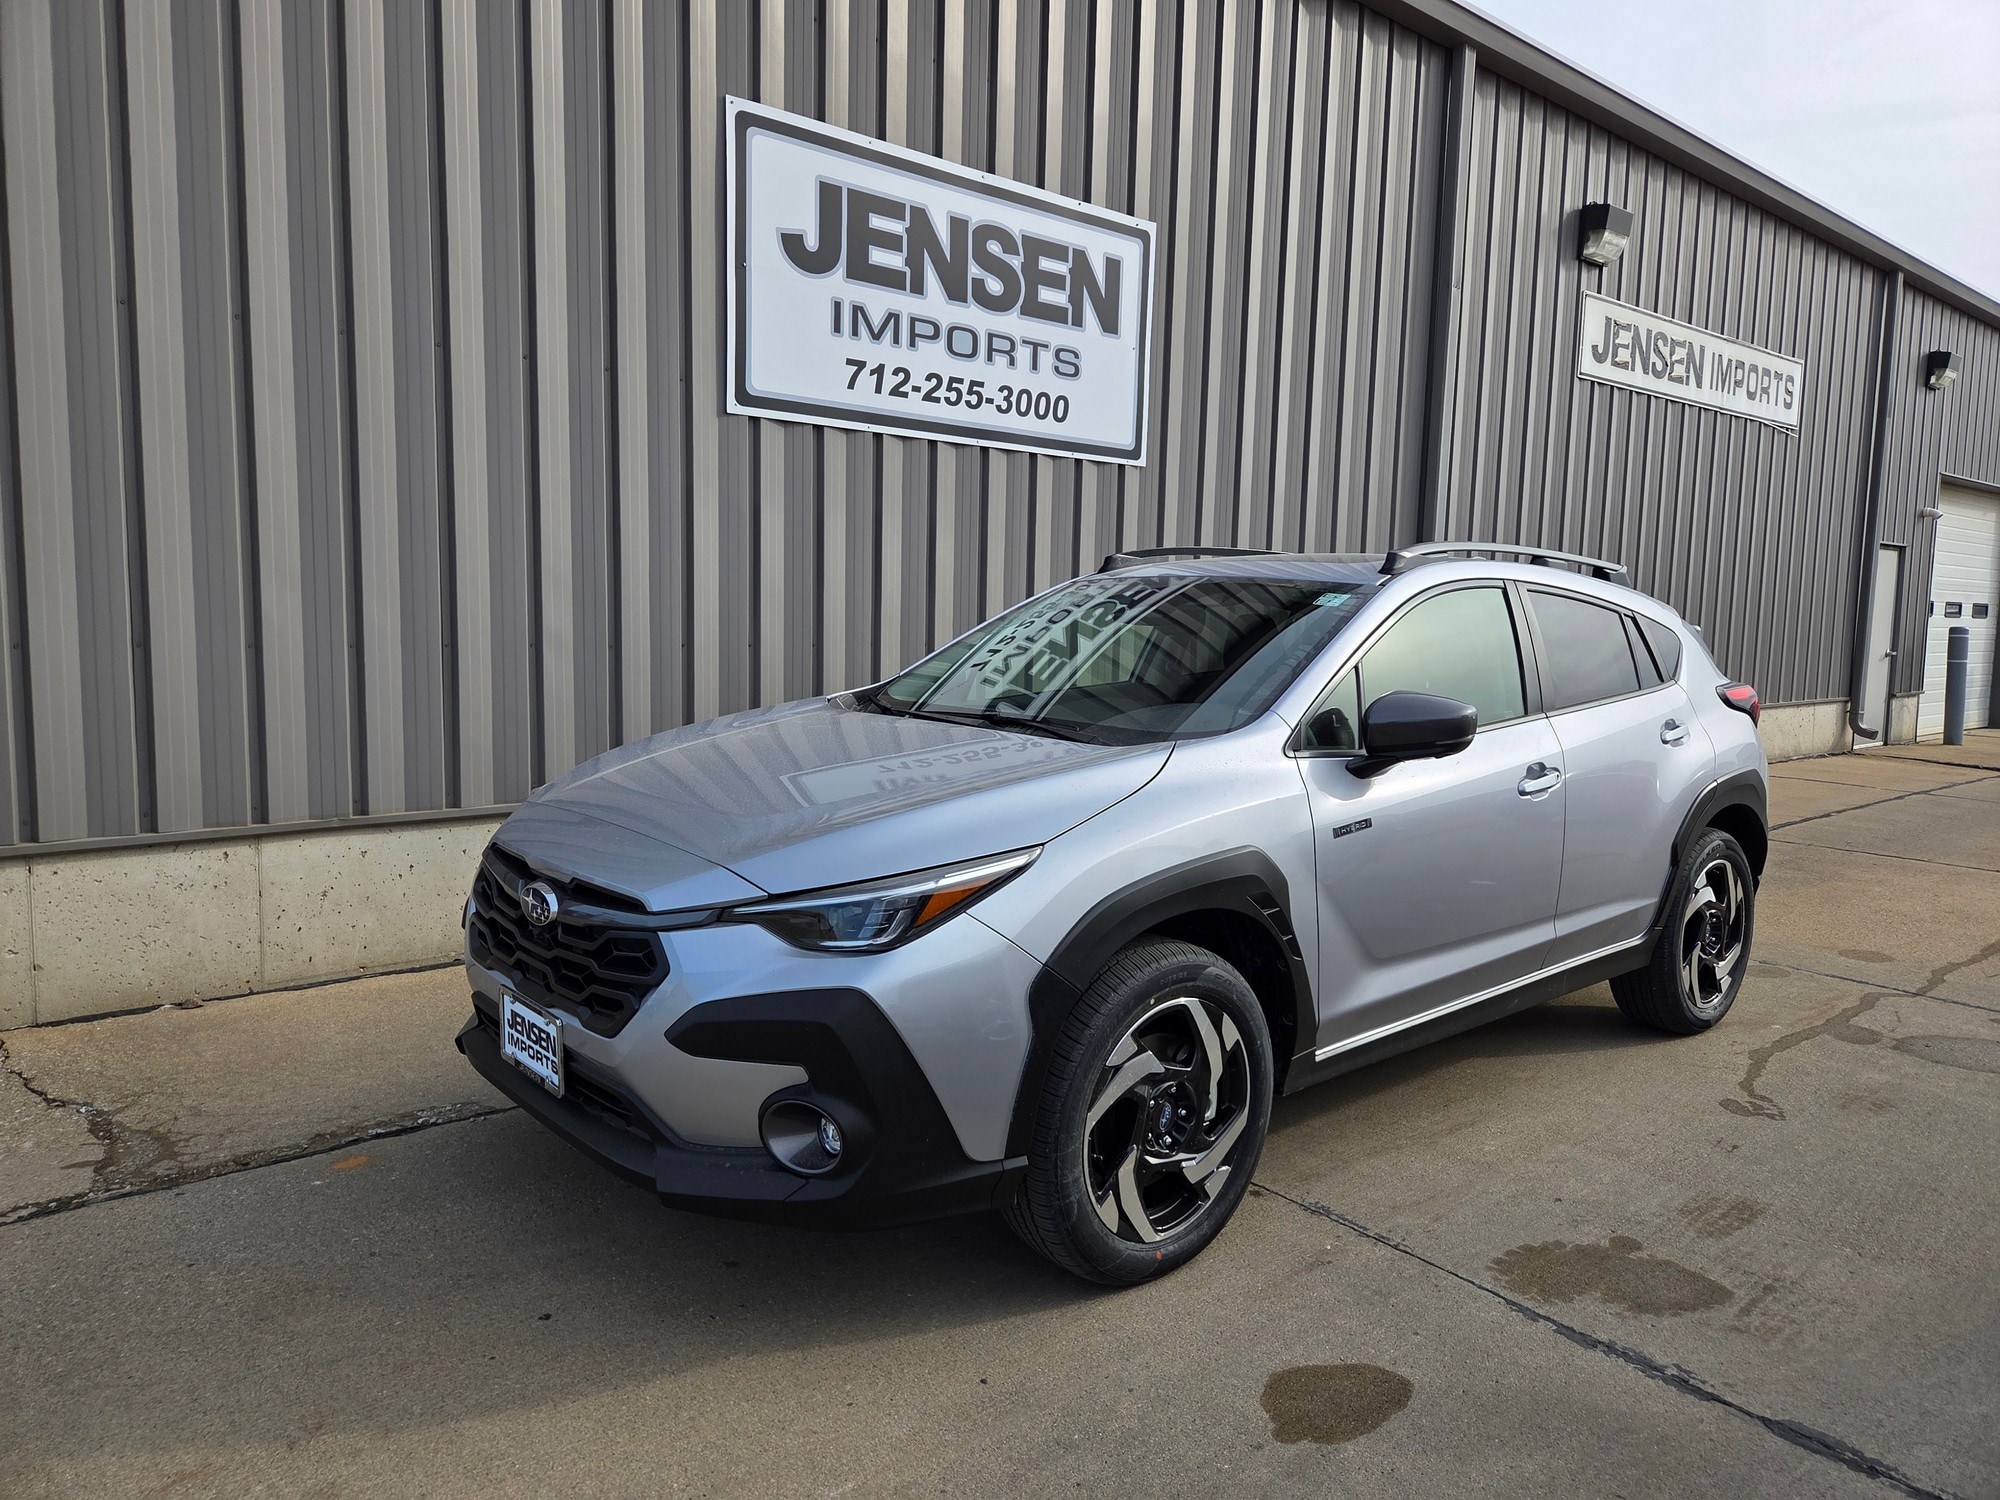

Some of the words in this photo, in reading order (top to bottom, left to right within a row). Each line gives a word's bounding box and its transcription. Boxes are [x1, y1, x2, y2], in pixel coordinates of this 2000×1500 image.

[778, 176, 1122, 337] JENSEN
[831, 298, 1081, 379] IMPORTS
[1591, 315, 1706, 390] JENSEN
[1709, 352, 1795, 410] IMPORTS
[844, 358, 1070, 423] 712-255-3000
[507, 1009, 557, 1059] JENSEN
[507, 1031, 559, 1075] IMPORTS
